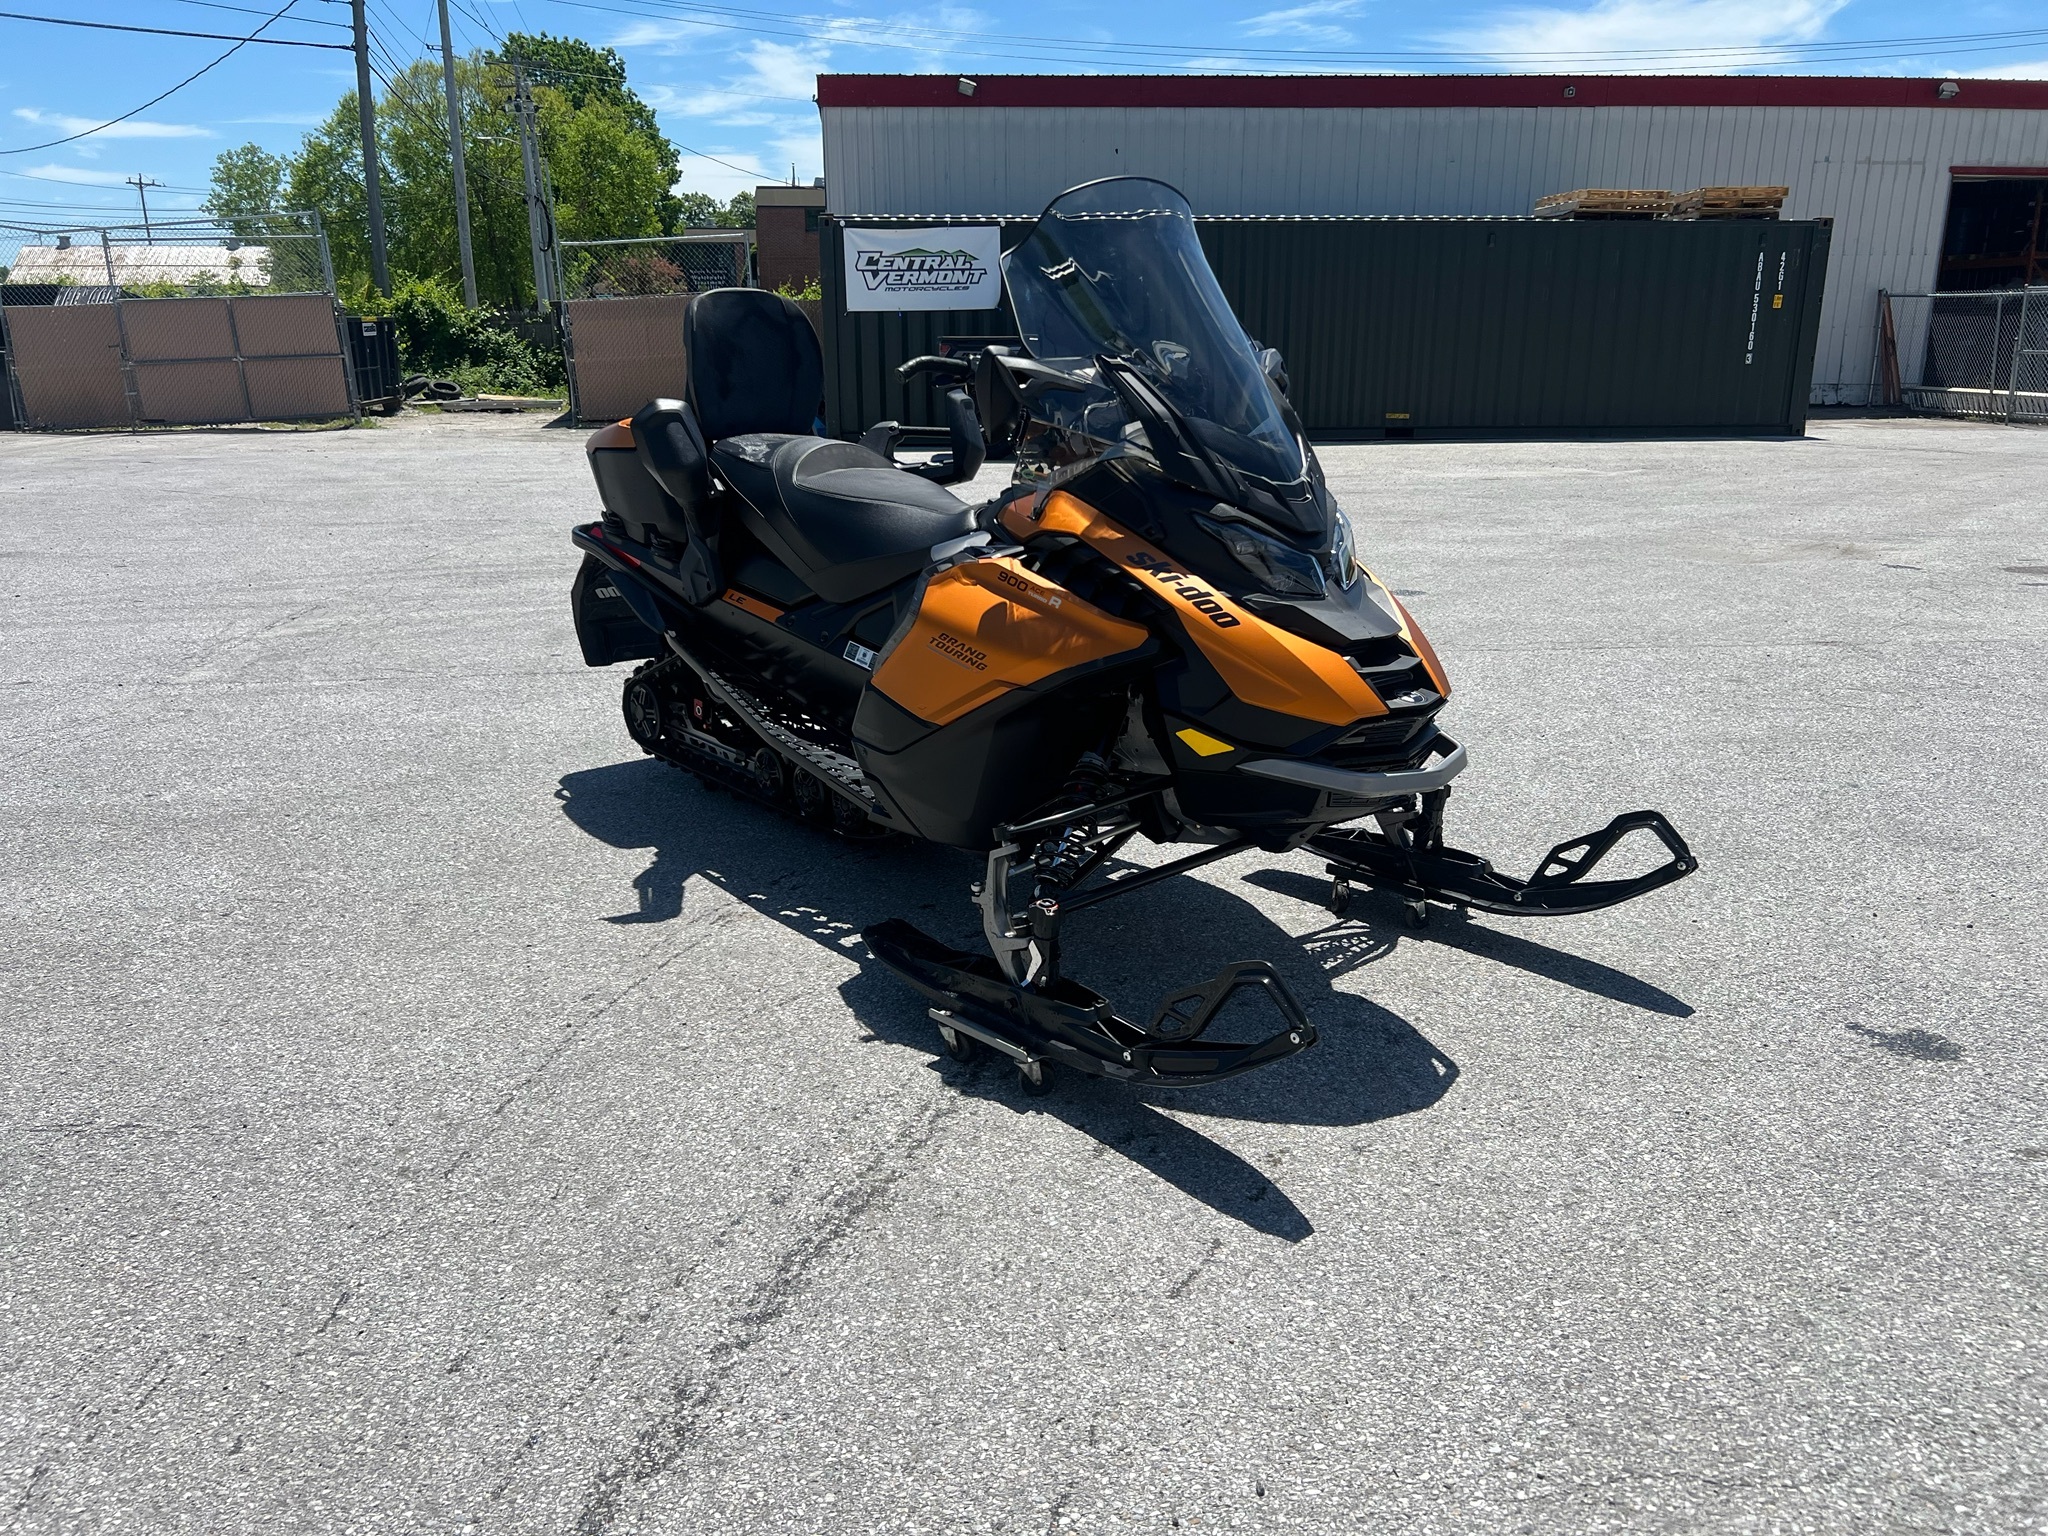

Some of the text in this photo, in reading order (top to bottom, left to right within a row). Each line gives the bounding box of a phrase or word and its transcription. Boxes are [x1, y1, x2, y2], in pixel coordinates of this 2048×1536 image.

[855, 251, 973, 271] CENTRAL
[1778, 251, 1786, 290] 42G1
[862, 268, 988, 290] VERMONT
[1745, 252, 1764, 364] ABAU 530160 3
[997, 571, 1029, 592] 900
[728, 593, 747, 605] LE
[1048, 595, 1062, 609] R
[929, 636, 988, 672] TOURING
[938, 632, 987, 661] GRAND
